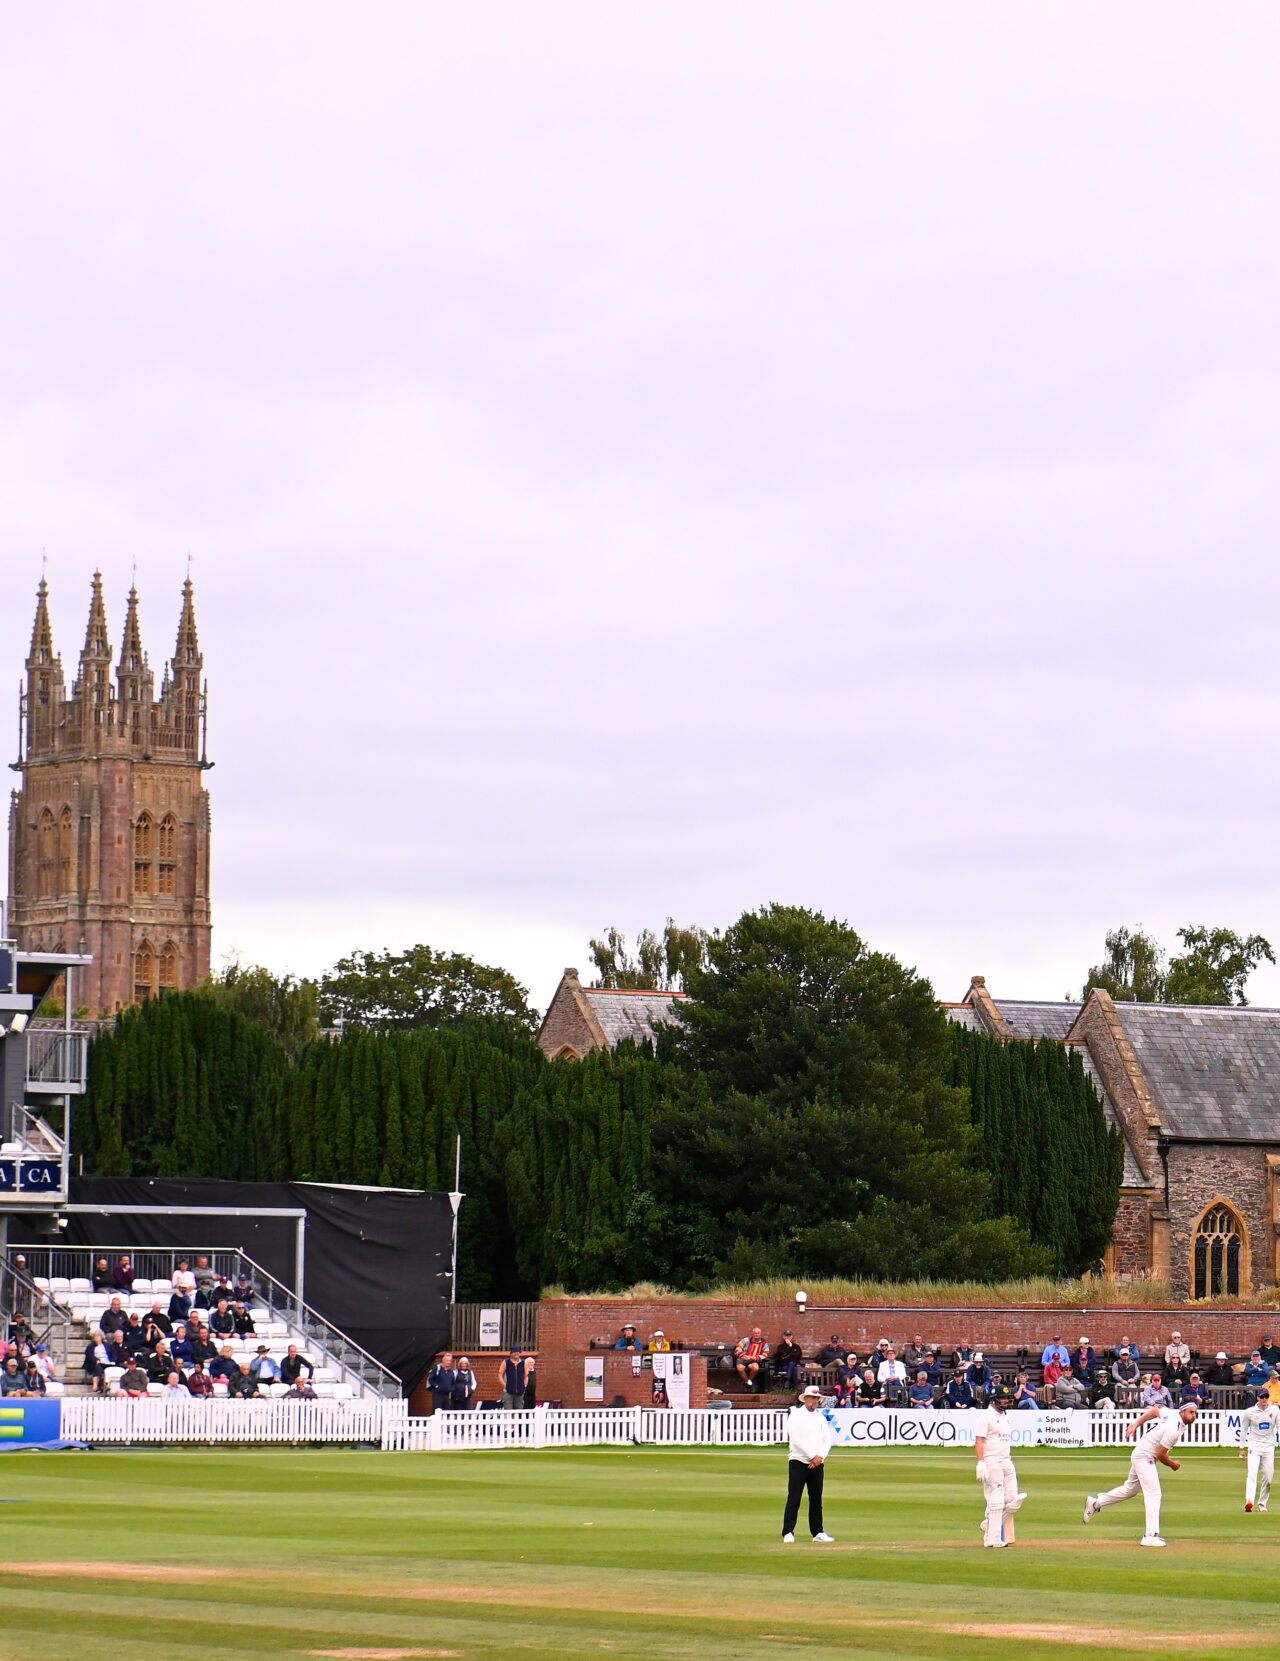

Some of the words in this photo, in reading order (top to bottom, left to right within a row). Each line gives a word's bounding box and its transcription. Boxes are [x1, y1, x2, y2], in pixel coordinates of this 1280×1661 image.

[28, 1168, 52, 1183] CA
[1046, 1416, 1067, 1424] Sport
[1045, 1437, 1084, 1446] Wellbeing
